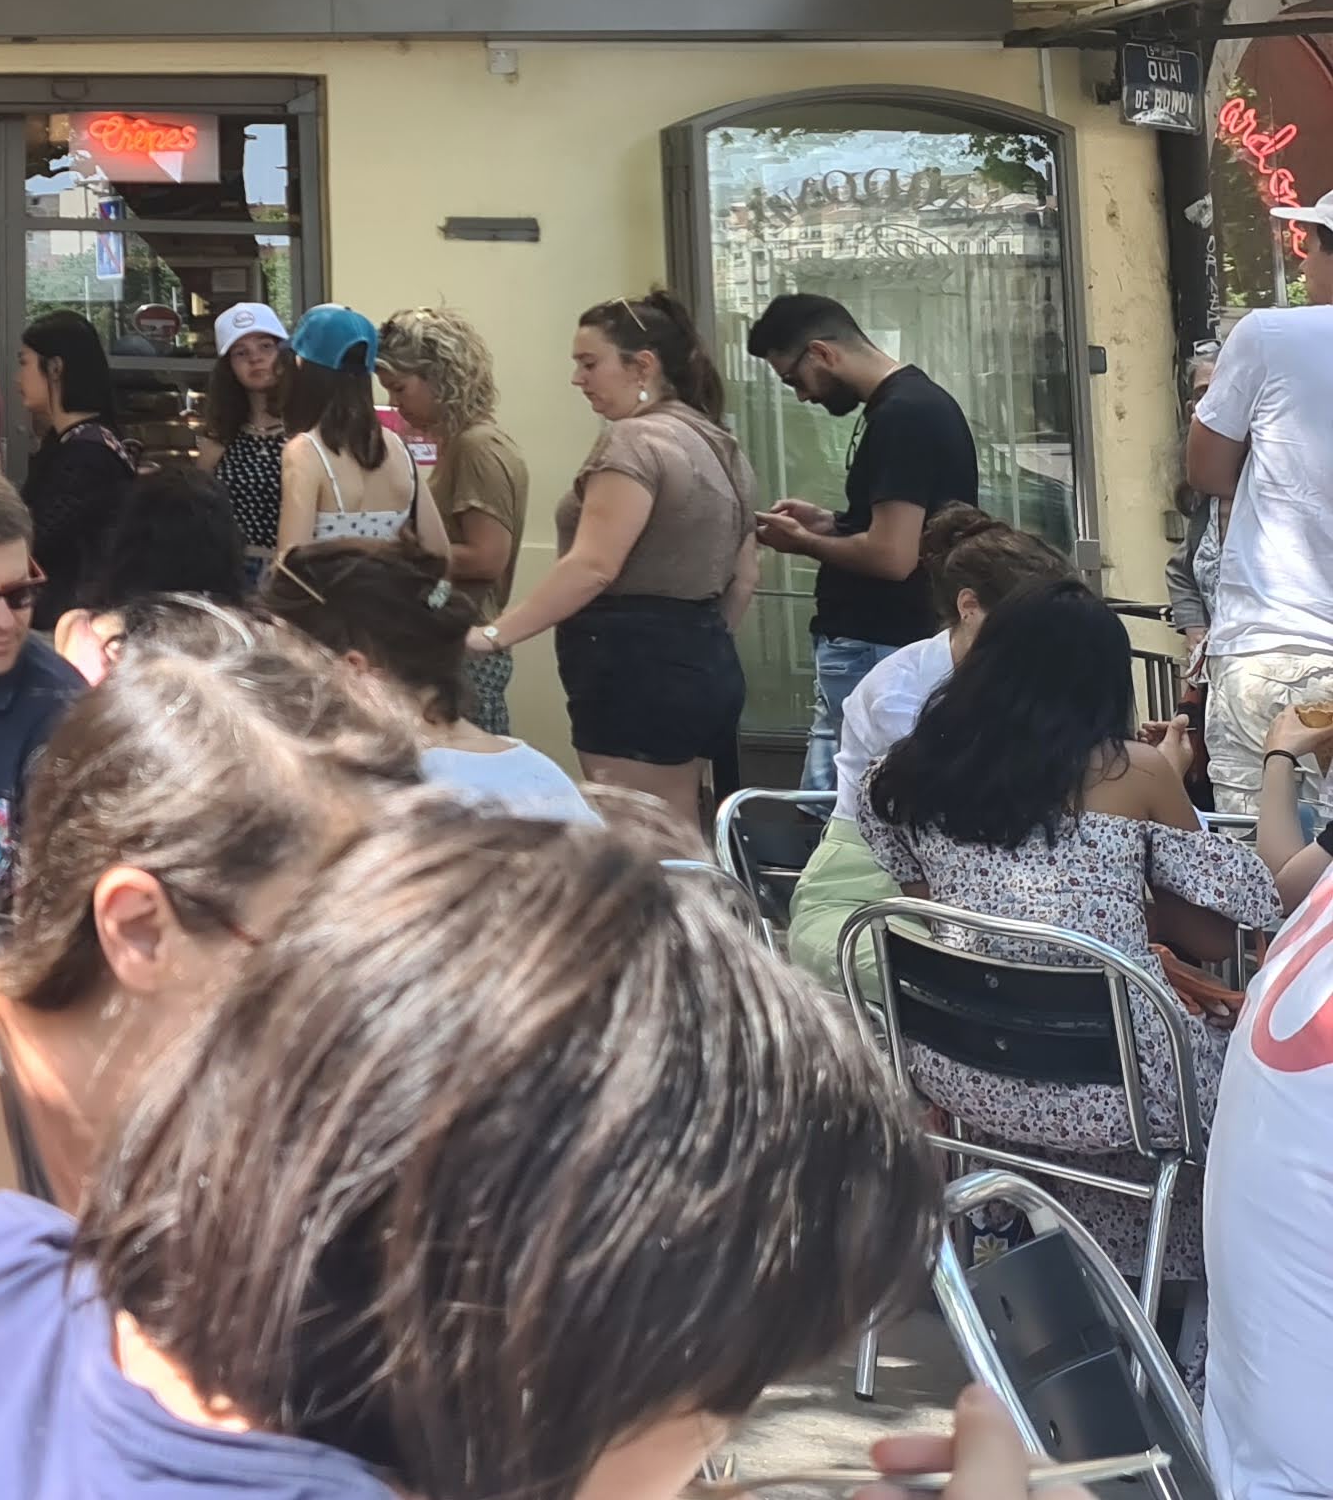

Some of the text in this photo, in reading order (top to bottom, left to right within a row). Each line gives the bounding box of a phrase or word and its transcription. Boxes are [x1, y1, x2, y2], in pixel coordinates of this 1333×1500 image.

[1147, 60, 1182, 84] QUAI
[1135, 88, 1194, 116] DE BONDY
[89, 115, 198, 155] Crêpes
